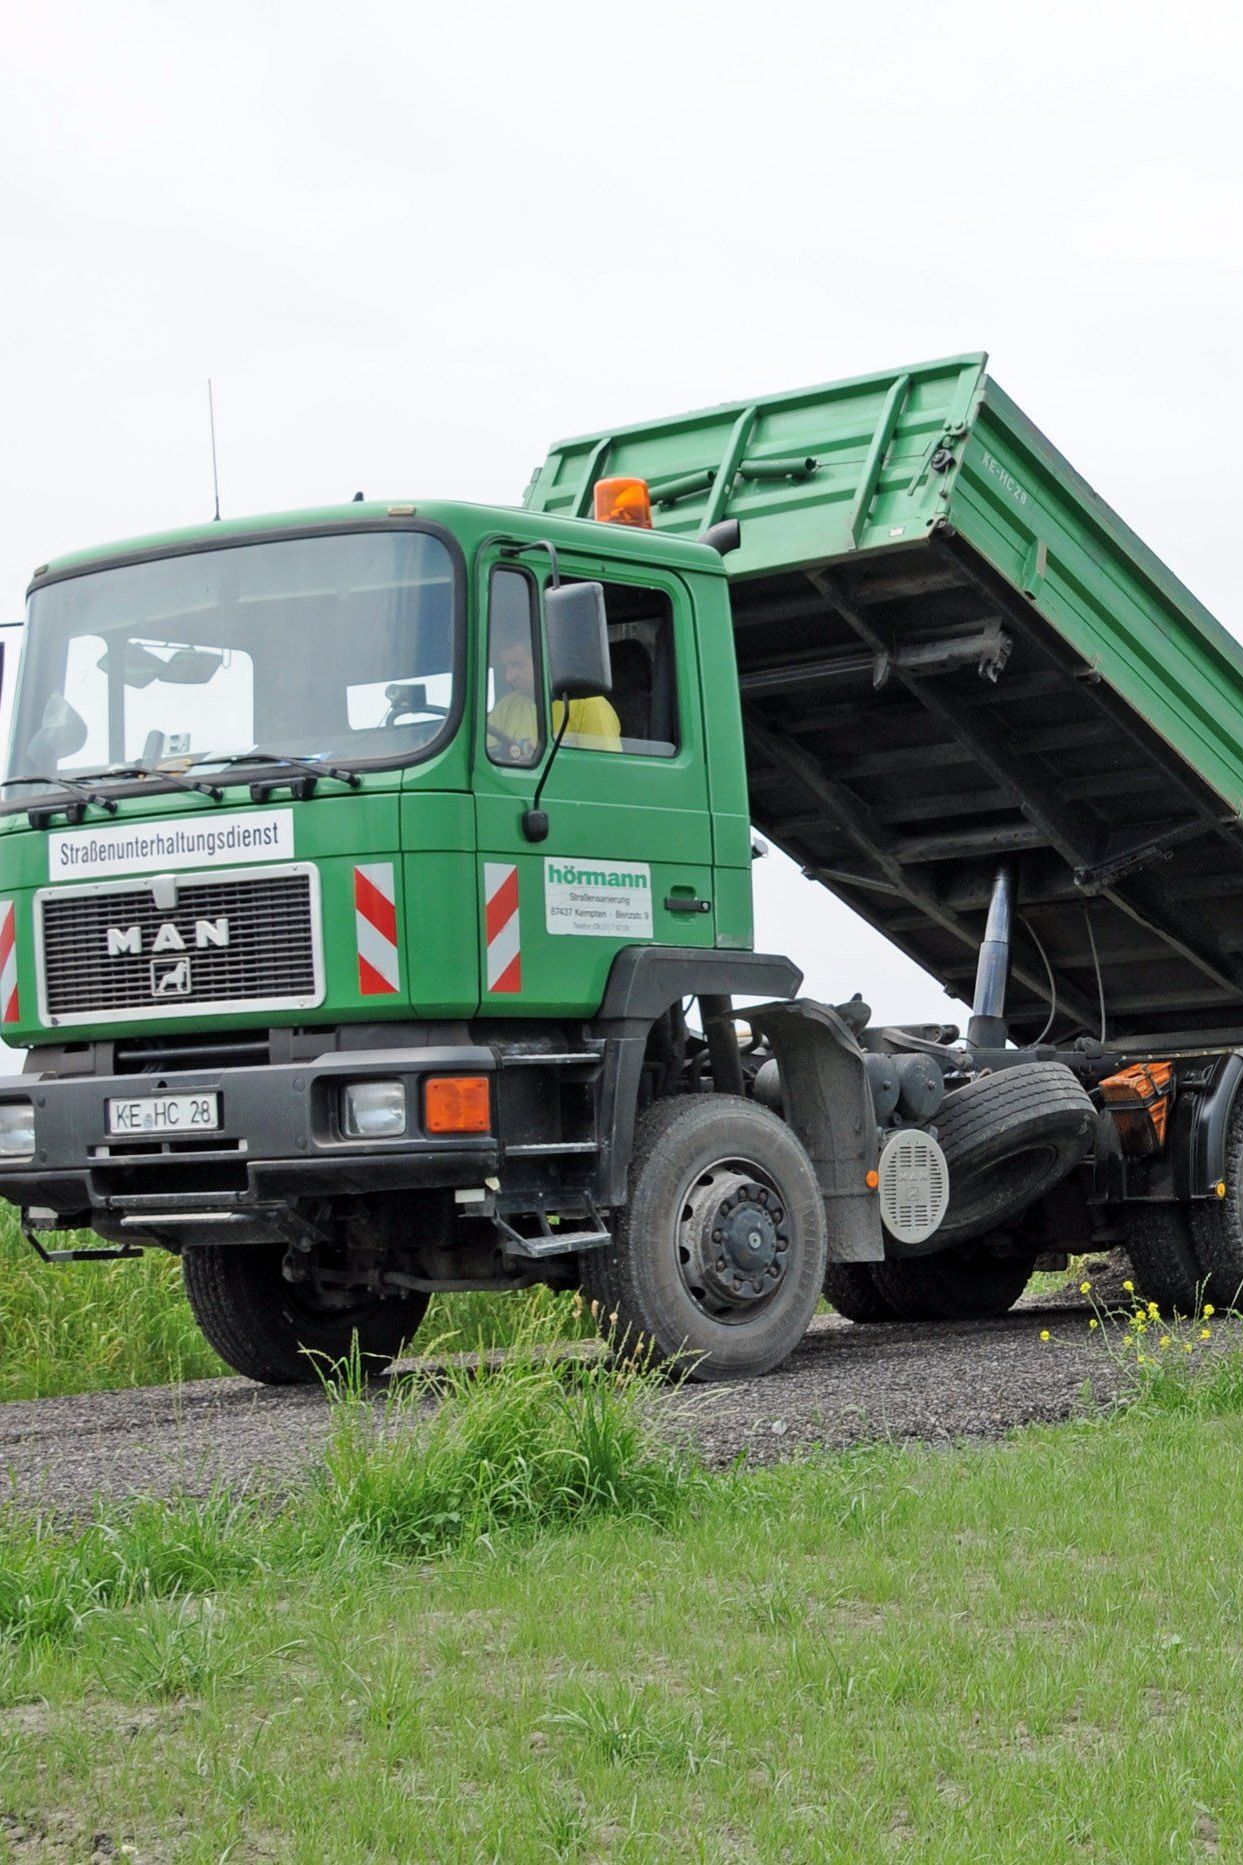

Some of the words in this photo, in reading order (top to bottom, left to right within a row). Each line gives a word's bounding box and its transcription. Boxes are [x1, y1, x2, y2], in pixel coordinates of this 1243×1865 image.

[60, 822, 279, 866] Straßenunterhaltungsdienst
[548, 864, 648, 889] hörmann
[107, 918, 230, 955] MAN
[116, 1104, 142, 1129] KE
[154, 1101, 180, 1127] HC
[190, 1100, 211, 1123] 28
